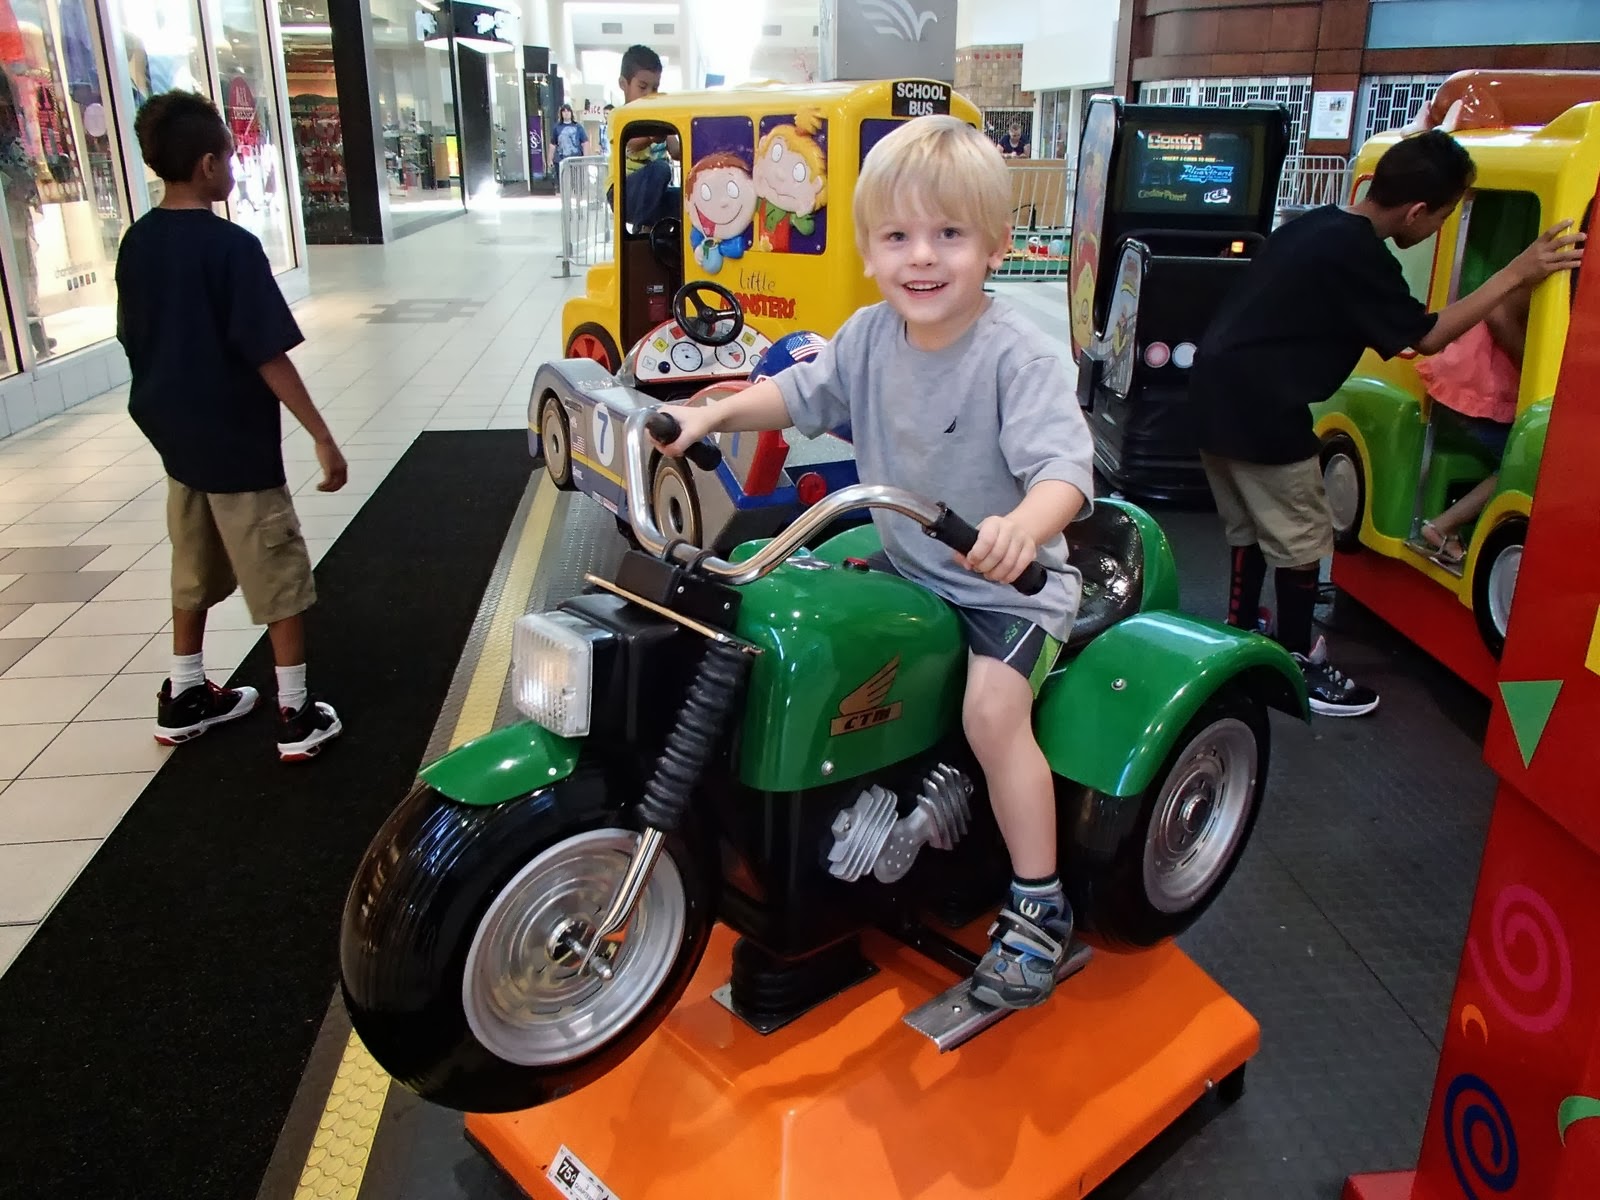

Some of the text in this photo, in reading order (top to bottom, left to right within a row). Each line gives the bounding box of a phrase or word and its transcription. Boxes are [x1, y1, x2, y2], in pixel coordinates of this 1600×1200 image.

[896, 82, 947, 101] SCHOOL
[908, 100, 934, 116] BUS
[597, 410, 609, 454] 7
